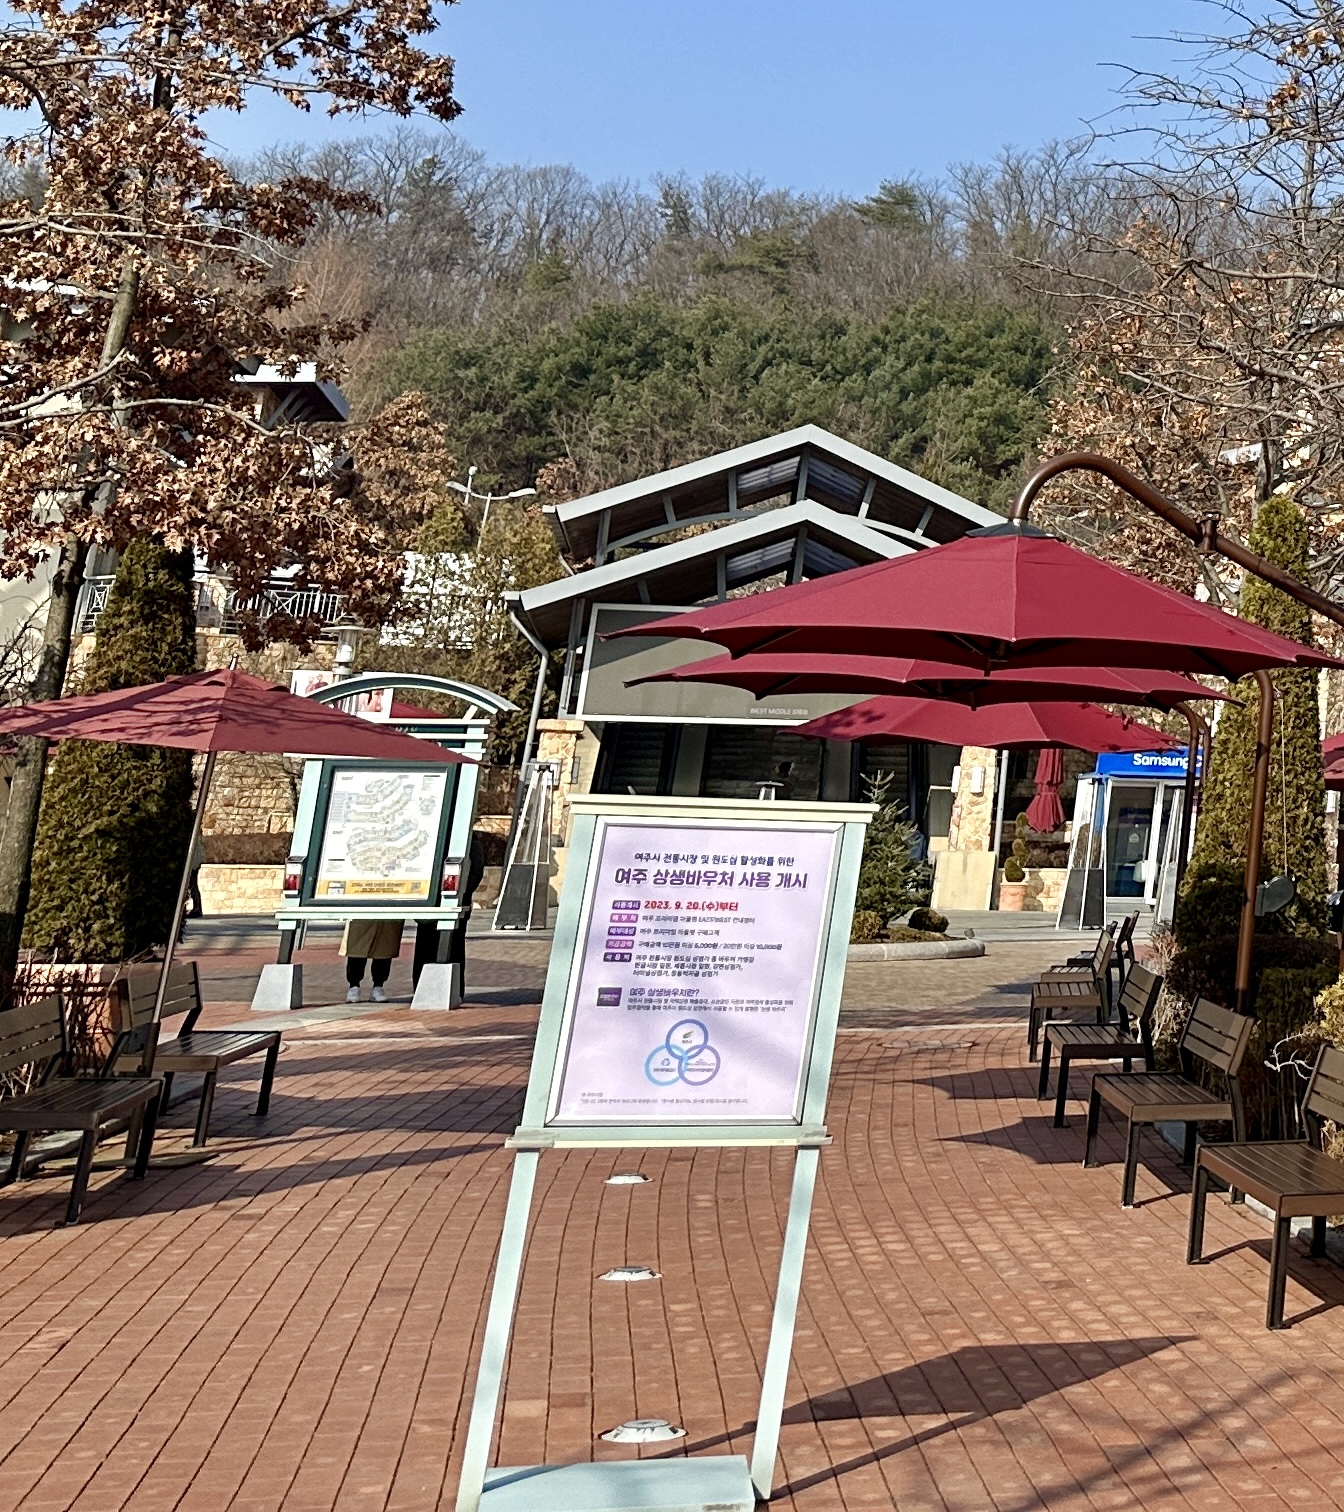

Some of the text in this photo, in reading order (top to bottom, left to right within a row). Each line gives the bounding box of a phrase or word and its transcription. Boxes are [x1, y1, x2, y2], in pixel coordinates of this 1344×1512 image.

[635, 852, 660, 863] 여주시
[663, 853, 698, 864] 전통시장
[777, 857, 795, 867] 위한
[615, 867, 809, 889] 여주 상생바우처 사용 개시
[644, 900, 671, 910] 2023.
